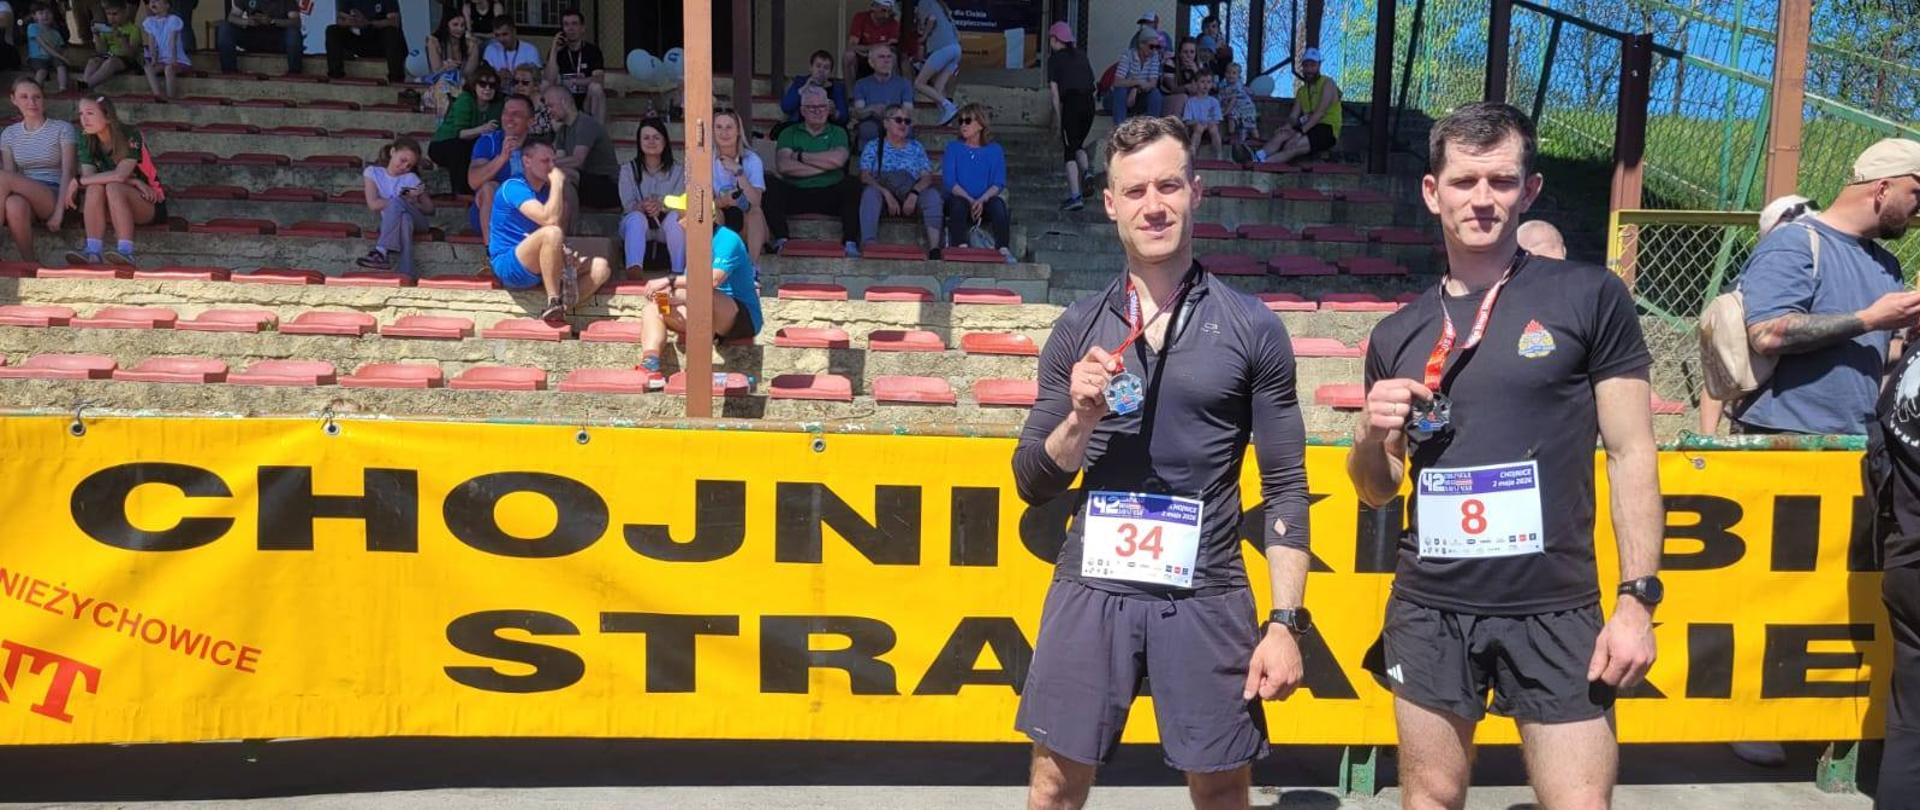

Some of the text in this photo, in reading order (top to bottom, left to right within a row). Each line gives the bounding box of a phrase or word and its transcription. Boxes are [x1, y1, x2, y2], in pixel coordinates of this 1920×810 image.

[70, 462, 1405, 573] CHOJNII
[1115, 522, 1163, 560] 34
[1461, 499, 1487, 535] 8
[443, 609, 1875, 698] STRAIE
